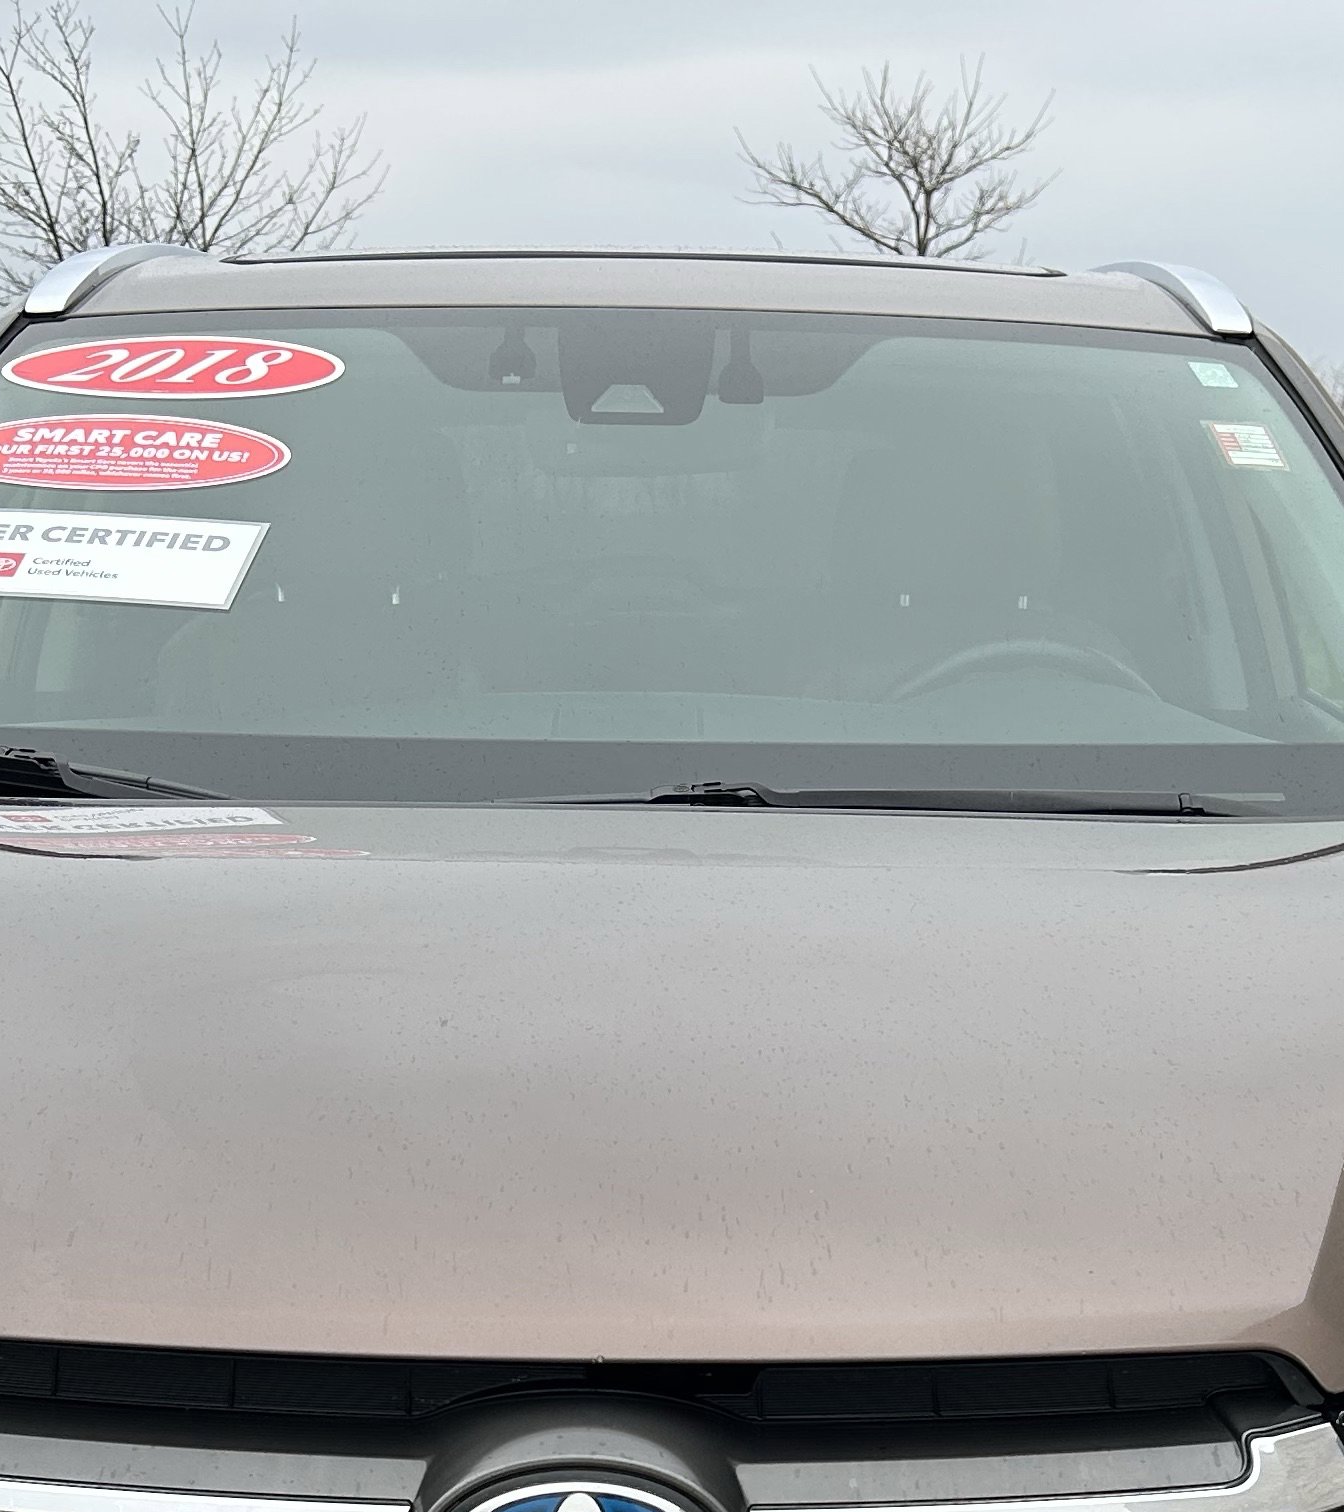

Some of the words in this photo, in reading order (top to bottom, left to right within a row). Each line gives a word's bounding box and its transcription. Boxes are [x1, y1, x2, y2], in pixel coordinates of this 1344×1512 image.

[47, 349, 293, 385] 2018
[13, 428, 131, 444] SMART
[133, 430, 223, 448] CARE
[34, 445, 95, 456] FIRST
[96, 446, 170, 459] 25,000
[172, 449, 209, 461] ON
[211, 451, 250, 463] US!
[41, 526, 231, 552] CERTIFIED
[32, 557, 91, 567] Certified
[27, 568, 62, 576] Used
[65, 569, 119, 579] Vehicles
